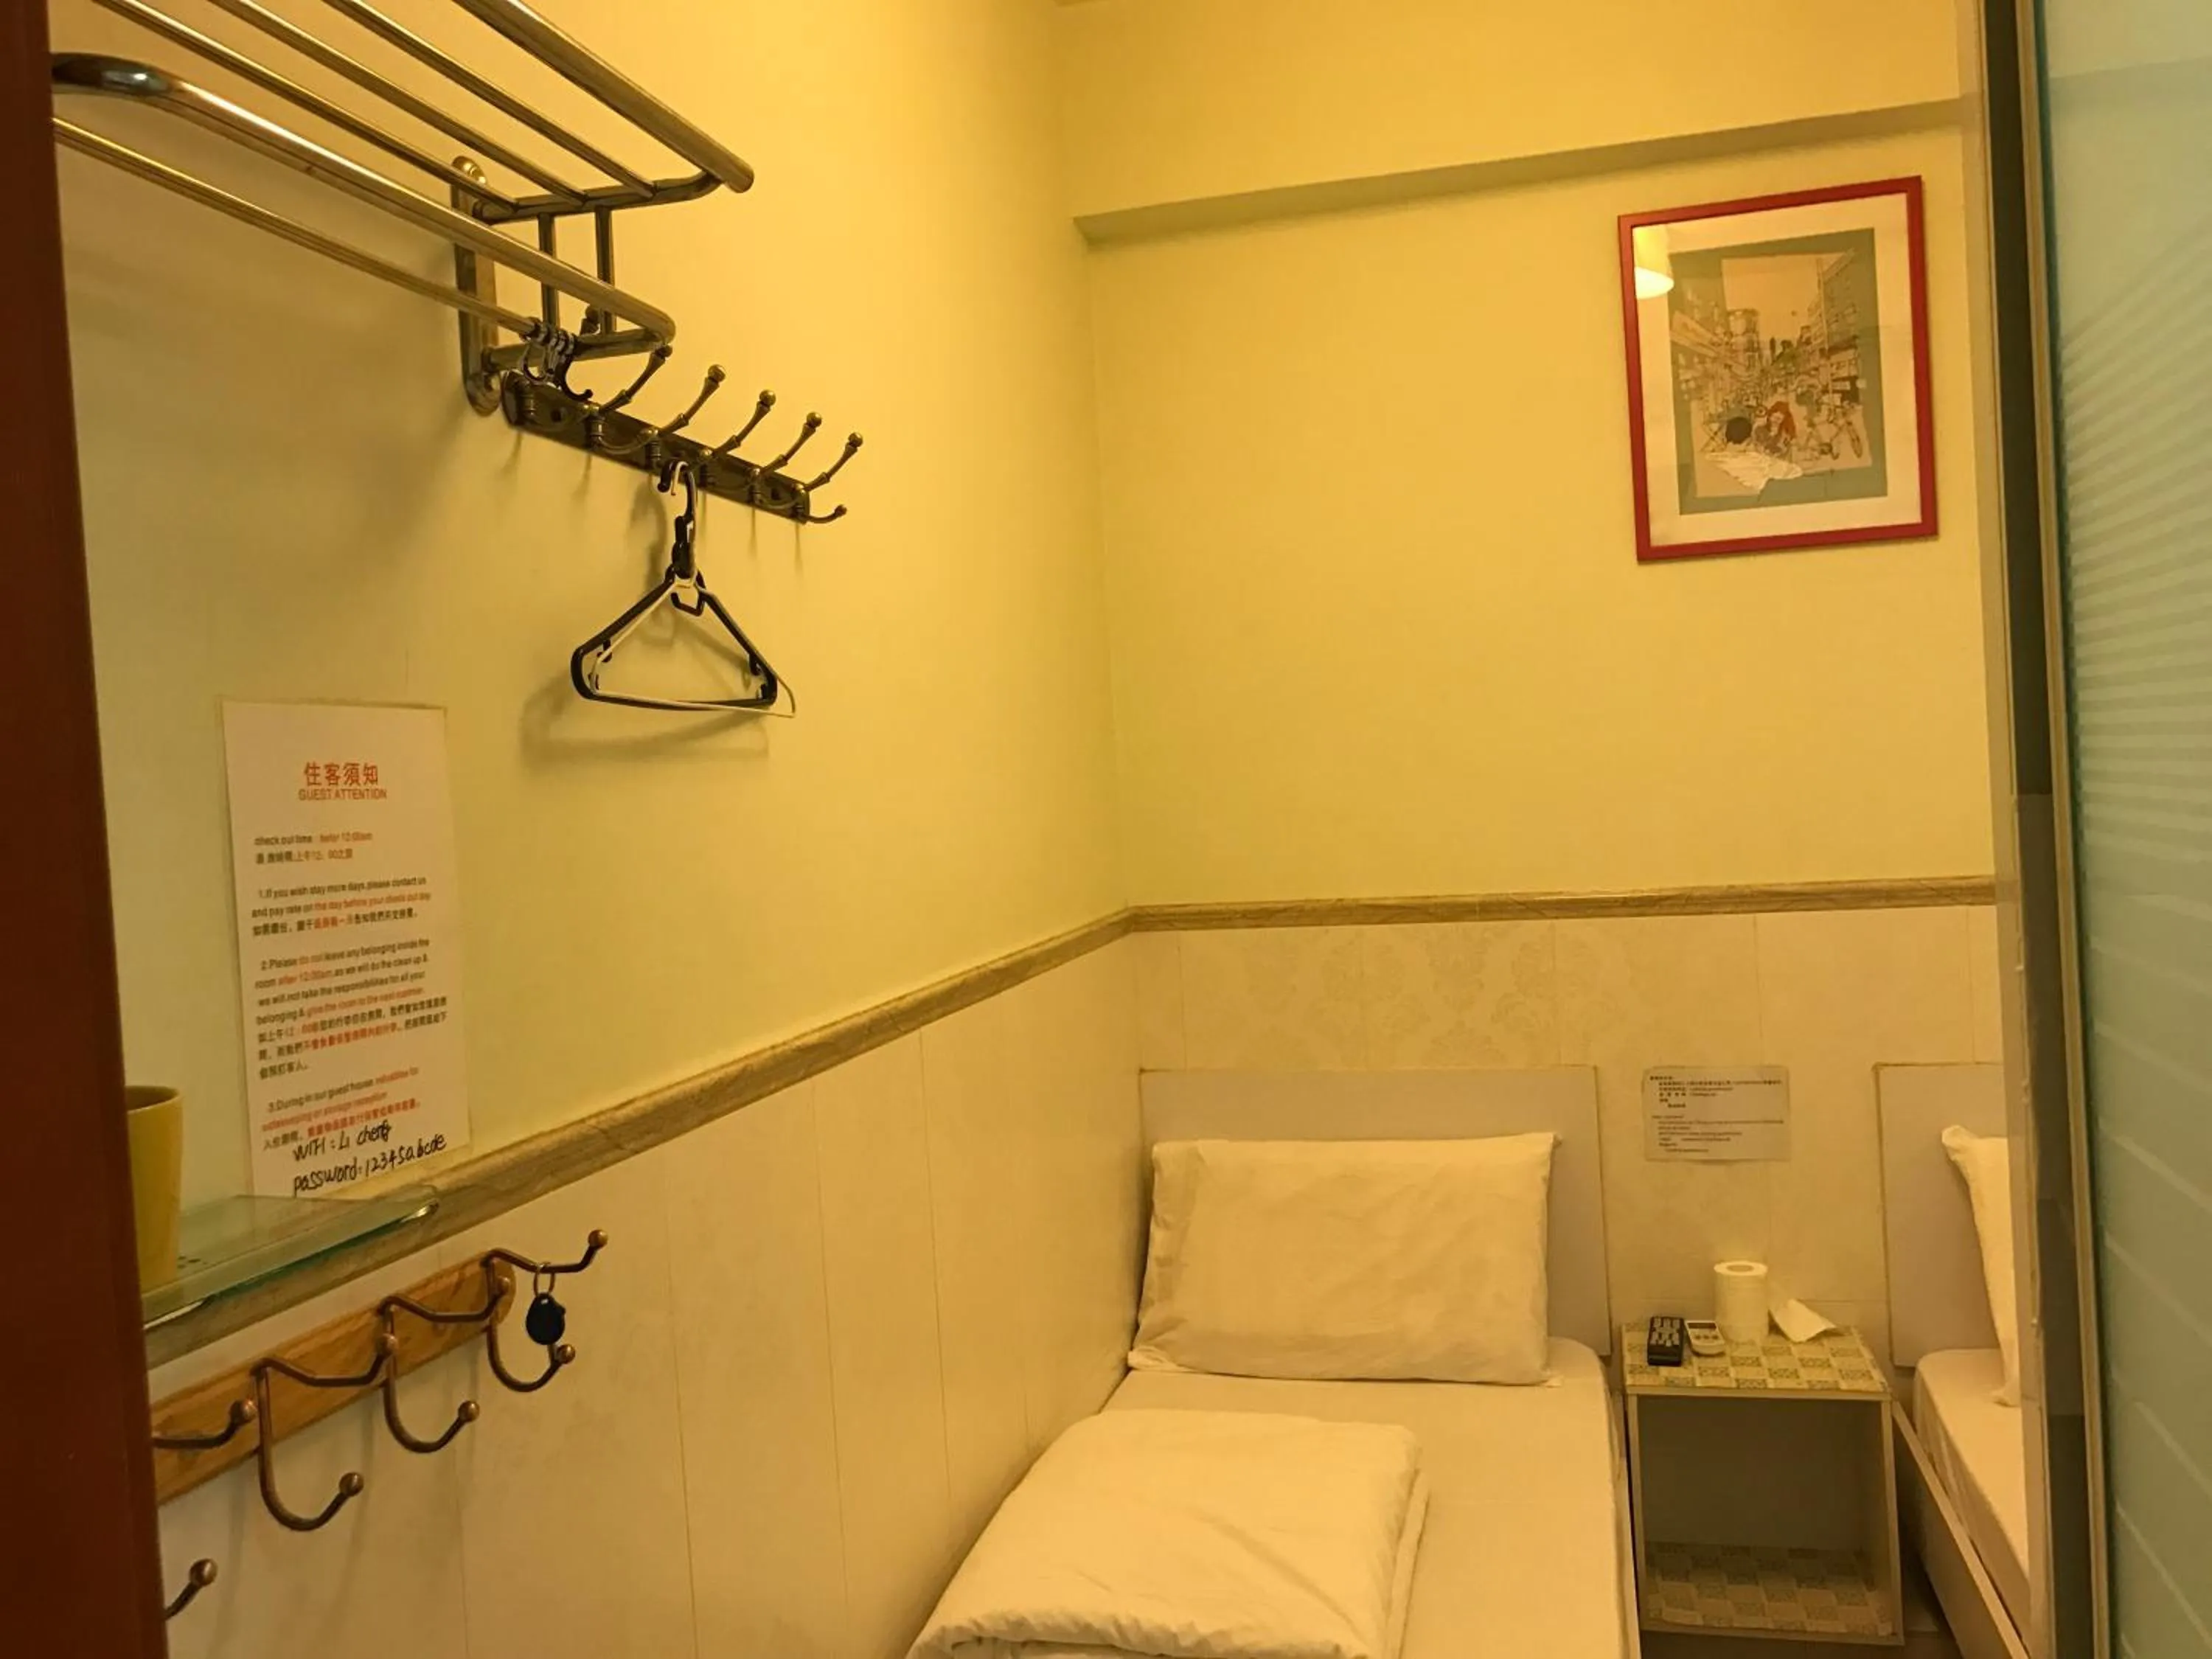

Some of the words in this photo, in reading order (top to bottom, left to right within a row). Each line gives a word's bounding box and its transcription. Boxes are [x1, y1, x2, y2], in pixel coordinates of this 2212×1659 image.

[304, 761, 378, 786] 住客須知
[298, 788, 332, 801] GUEST
[334, 787, 387, 800] ATTENTION
[254, 835, 279, 846] check
[274, 889, 288, 899] you
[290, 887, 308, 897] wish
[310, 885, 325, 895] stay
[327, 884, 346, 893] more
[251, 908, 268, 919] and
[269, 908, 284, 919] pay
